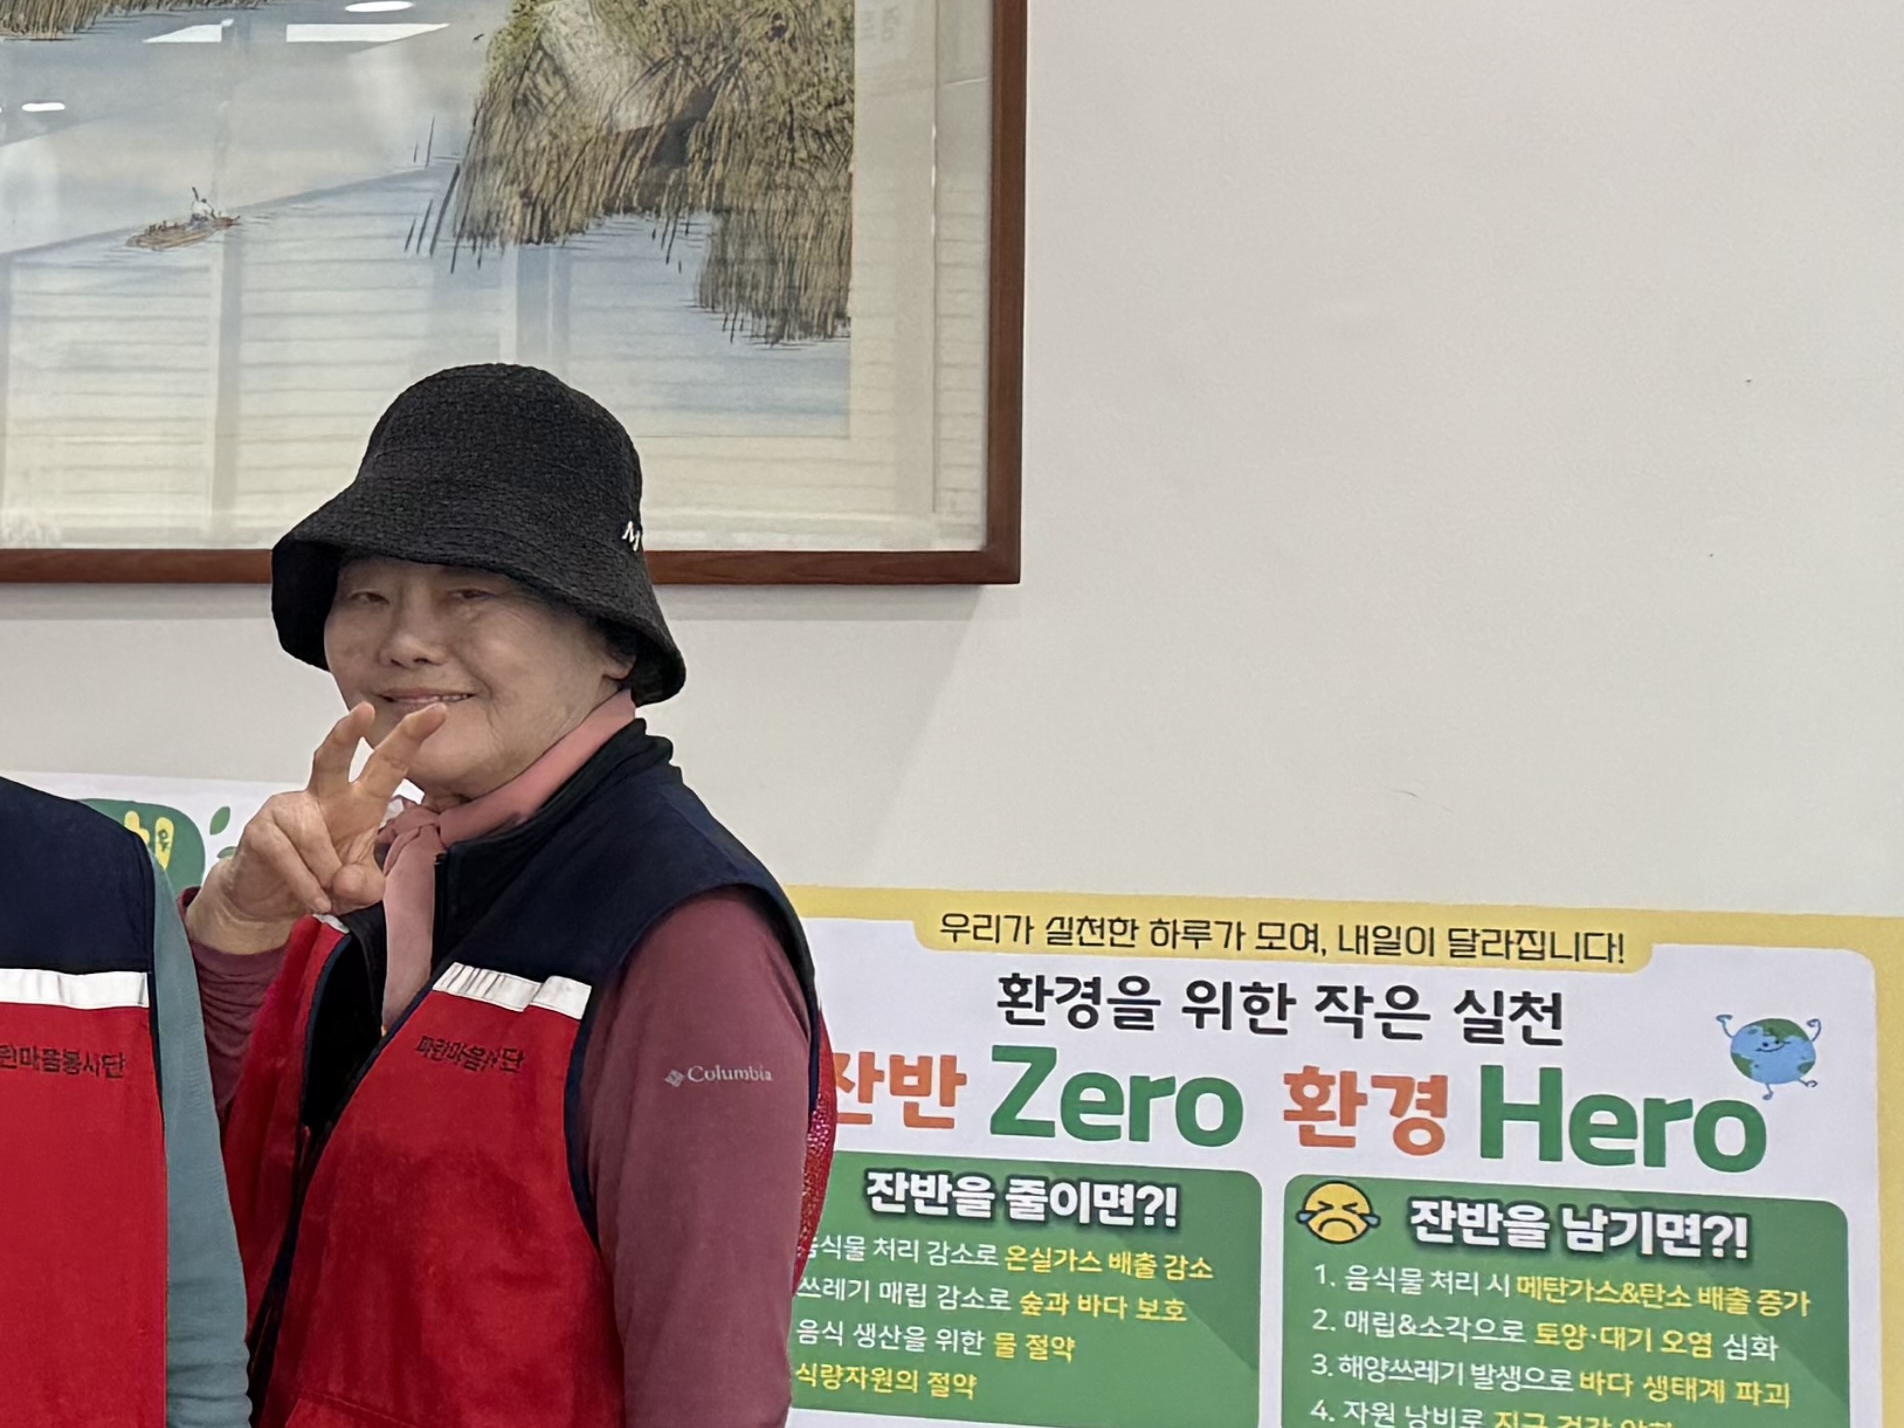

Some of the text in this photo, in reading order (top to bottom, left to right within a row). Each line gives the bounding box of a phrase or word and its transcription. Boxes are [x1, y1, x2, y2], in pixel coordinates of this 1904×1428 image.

[940, 913, 1625, 964] 우리가 실천한 하루가 모여, 내일이 달라집니다!
[997, 972, 1564, 1046] 환경을 위한 작은 실천
[687, 1064, 773, 1083] Columbia
[833, 1044, 1767, 1174] 잔반 Zero 환경 Hero
[867, 1171, 1178, 1228] 잔반을 줄이면?!
[1410, 1199, 1750, 1259] 잔반을 남기면?!
[874, 1237, 919, 1264] 처리
[926, 1240, 999, 1267] 감소로
[1004, 1244, 1103, 1275] 온실가스
[1108, 1251, 1158, 1280] 배출
[1164, 1255, 1214, 1282] 감소
[796, 1277, 1188, 1323] 쓰레기 매립 감소로 숲과 바다 보호
[1315, 1263, 1811, 1318] 1. 음식물 처리 시 메탄가스&탄소 배출 증가
[796, 1318, 1075, 1362] 음식 생산을 위한 물 절약
[1313, 1309, 1336, 1332] 2.
[1344, 1309, 1526, 1345] 매립&소각으로
[1662, 1328, 1713, 1359] 오염
[1723, 1333, 1778, 1361] 심화
[795, 1362, 977, 1399] 식량자원의 절약
[1311, 1353, 1791, 1409] 3. 해양쓰레기 발생으로 바다 생태계 파괴
[1310, 1399, 1336, 1422] 4.
